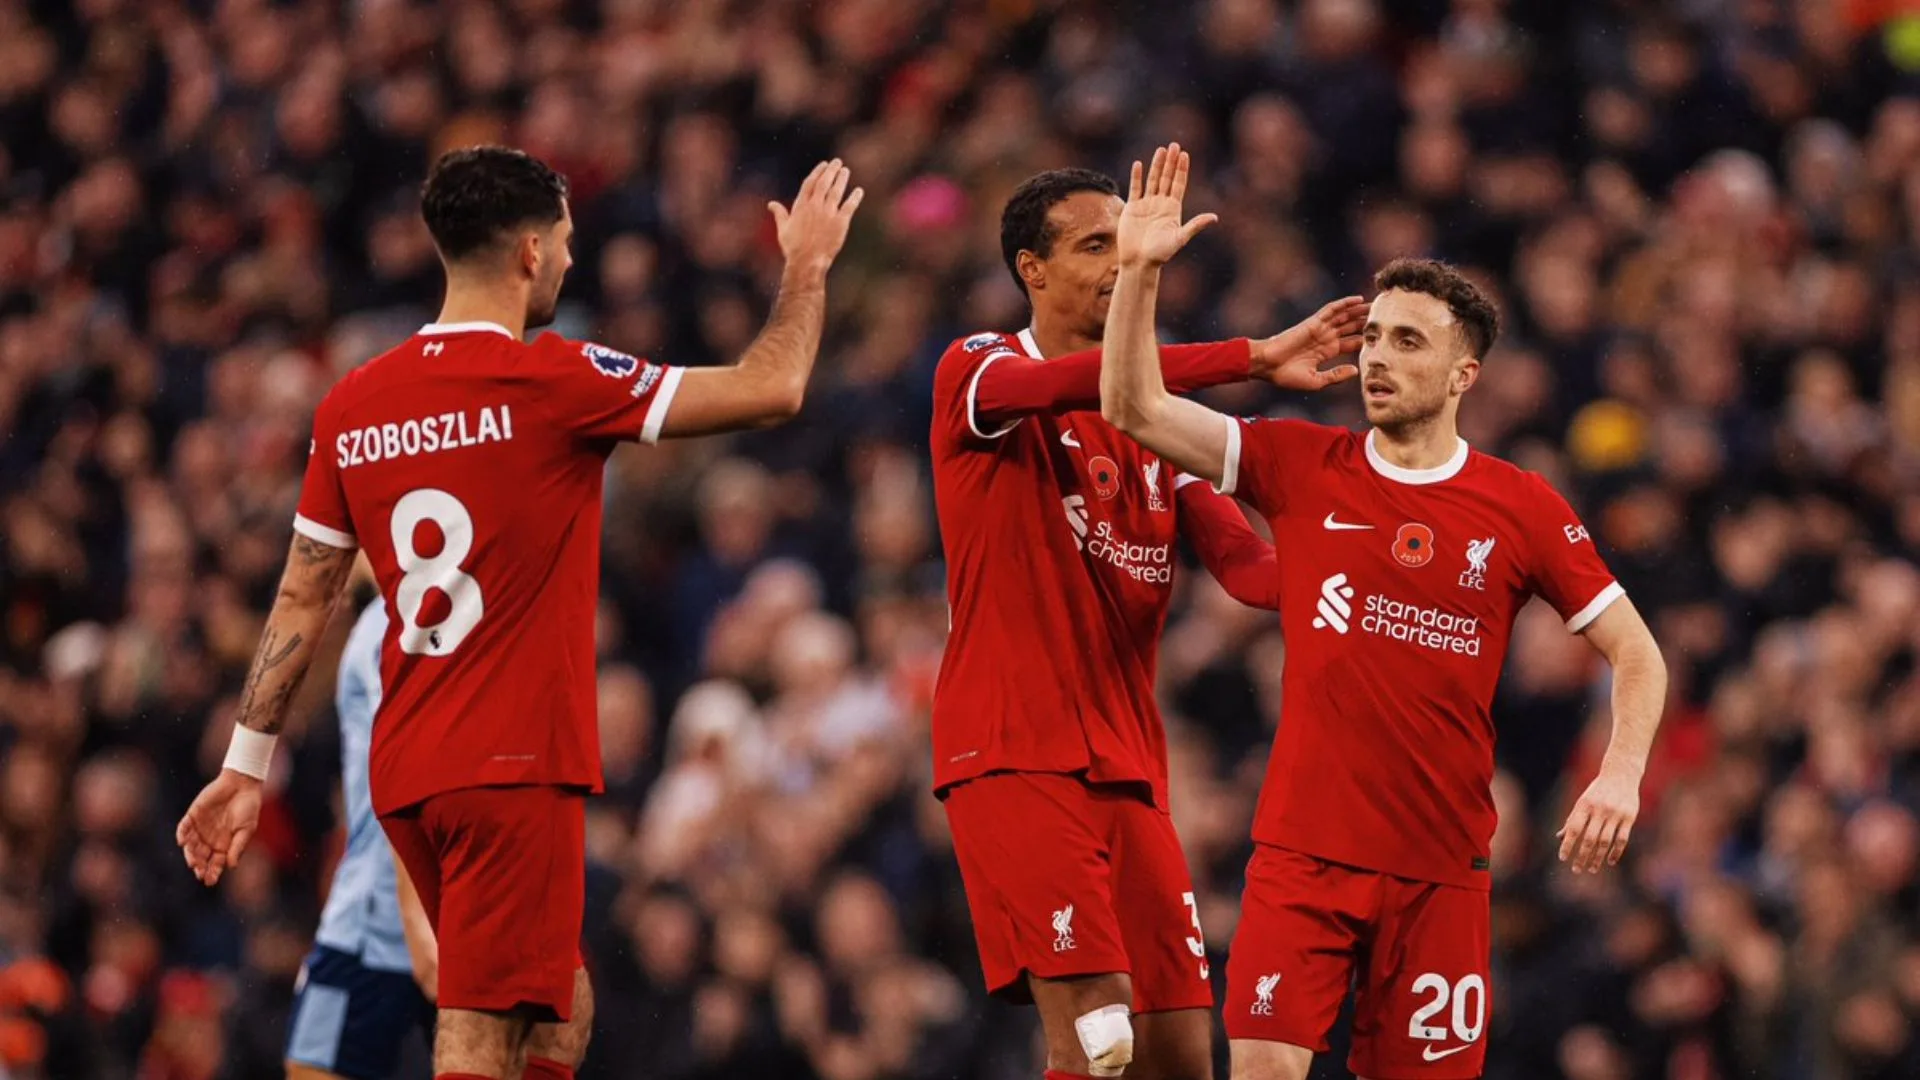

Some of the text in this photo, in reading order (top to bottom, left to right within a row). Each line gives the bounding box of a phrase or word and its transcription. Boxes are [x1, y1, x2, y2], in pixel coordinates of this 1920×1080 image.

[336, 405, 513, 469] SZOBOSZLAI
[390, 487, 484, 656] 8
[1458, 574, 1485, 590] LFC
[1361, 614, 1481, 656] chartered
[1364, 593, 1478, 635] standard
[1053, 938, 1077, 952] LFC
[1250, 1004, 1274, 1017] LFC
[1408, 972, 1485, 1042] 20
